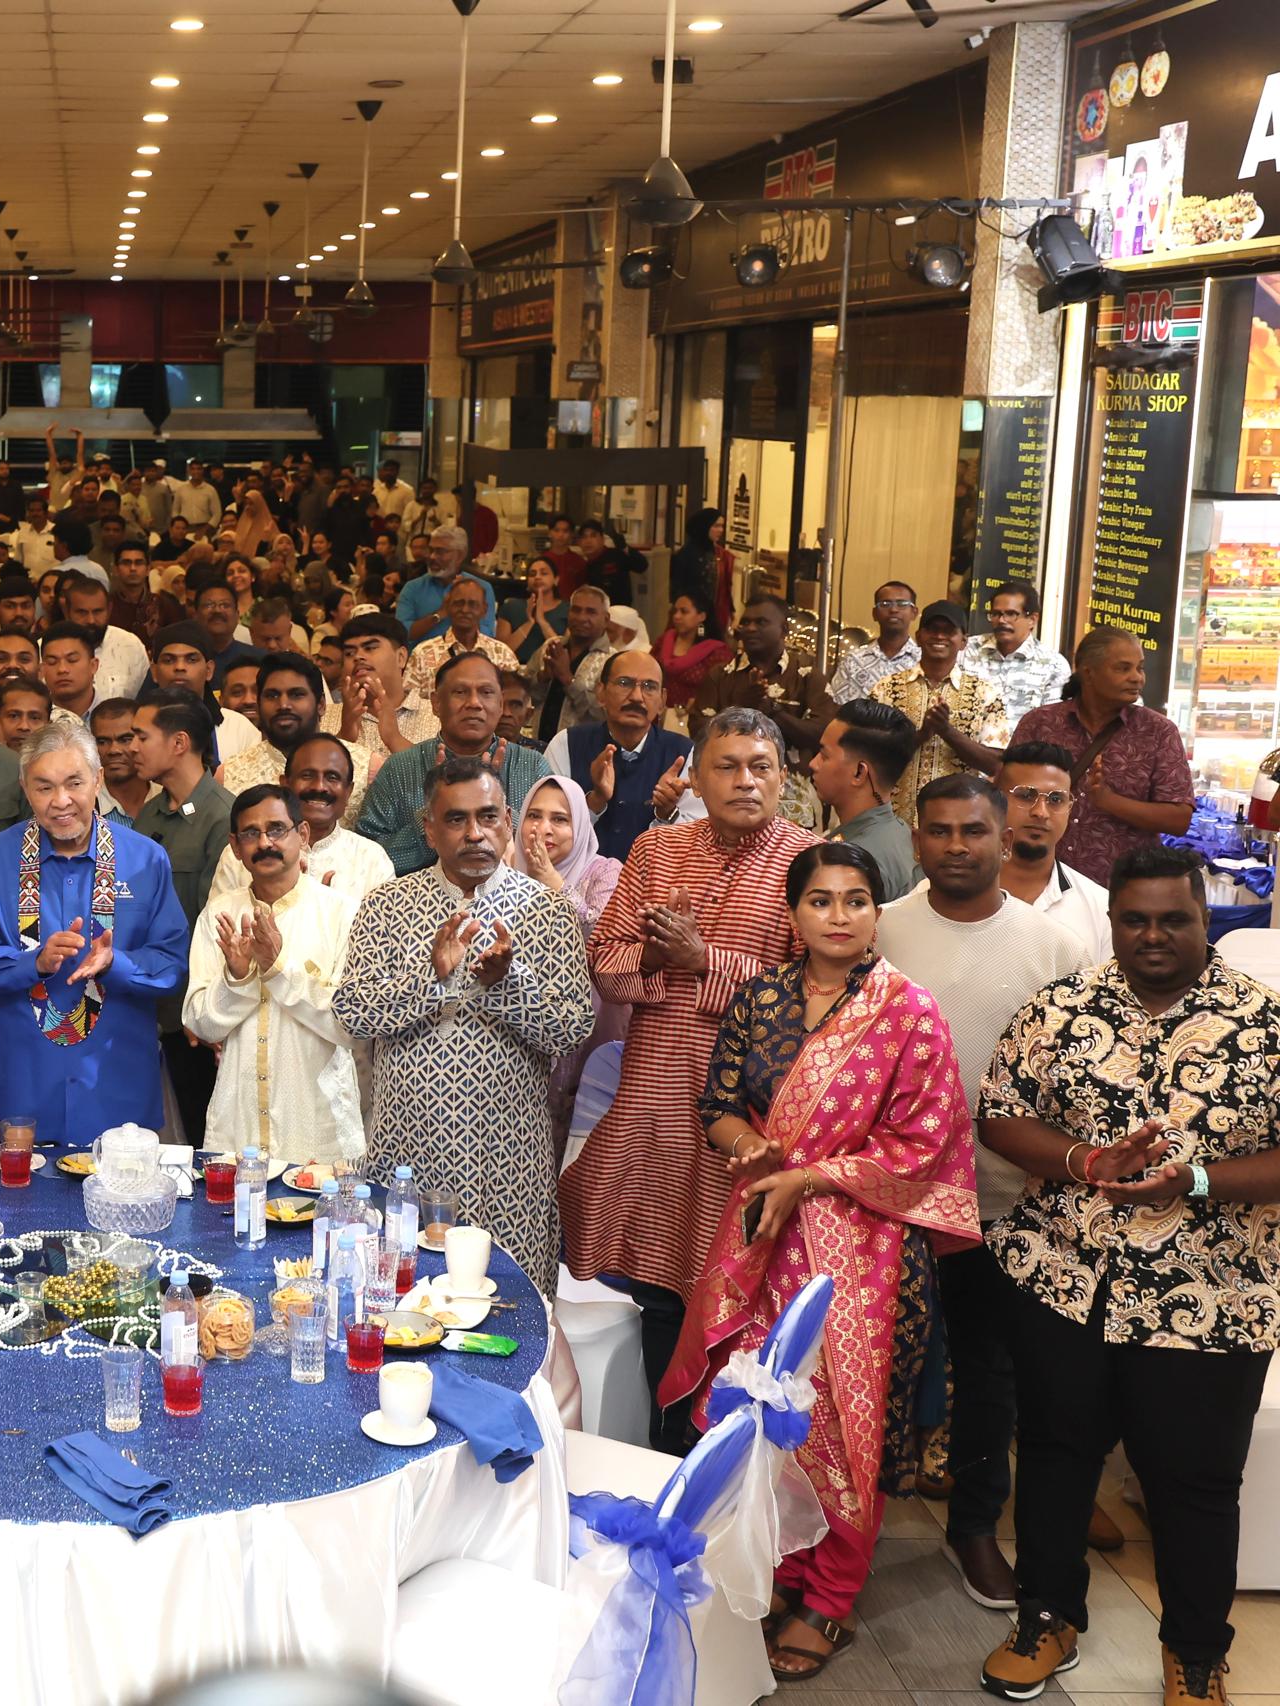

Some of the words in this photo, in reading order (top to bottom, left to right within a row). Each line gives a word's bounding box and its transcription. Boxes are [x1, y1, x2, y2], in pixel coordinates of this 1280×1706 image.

[1123, 289, 1172, 343] BTC
[1105, 372, 1181, 390] SAUDAGAR
[1096, 395, 1141, 411] KURMA
[1147, 395, 1188, 412] SHOP
[1086, 596, 1121, 614] Jualan
[1123, 603, 1161, 623] Kurma
[1094, 612, 1102, 624] &
[1104, 615, 1148, 635] Pelbagai
